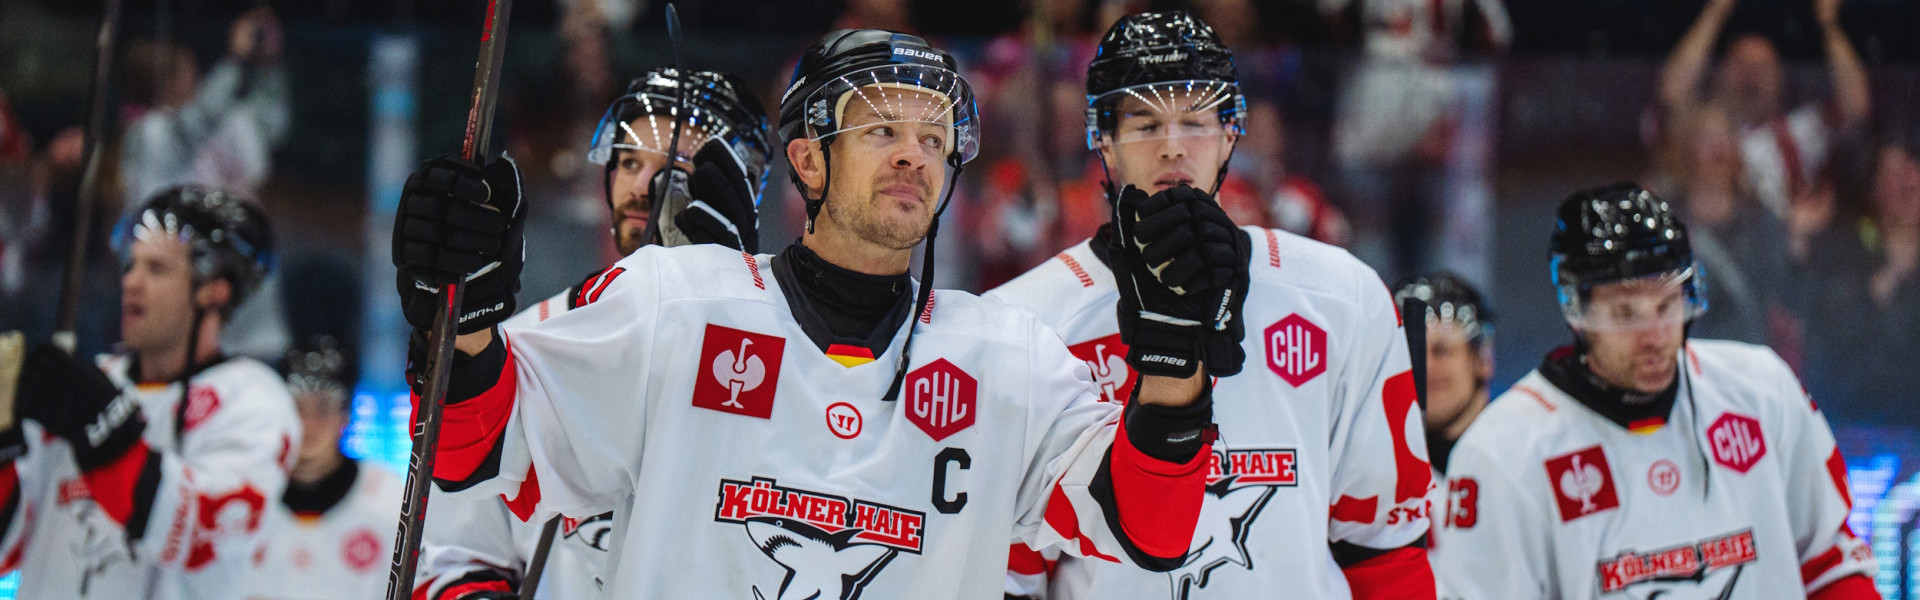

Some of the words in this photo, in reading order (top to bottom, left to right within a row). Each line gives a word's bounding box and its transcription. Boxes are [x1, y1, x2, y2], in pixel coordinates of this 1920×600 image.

[893, 47, 944, 62] BAUER
[1214, 289, 1232, 321] BAUER
[1141, 354, 1187, 367] BAUER
[1271, 324, 1320, 376] CHL
[914, 371, 967, 428] CHL
[1713, 418, 1760, 466] CHL
[931, 447, 971, 514] C
[1230, 452, 1294, 483] HAIE
[720, 481, 847, 528] KÖLNER
[855, 502, 922, 549] HAIE
